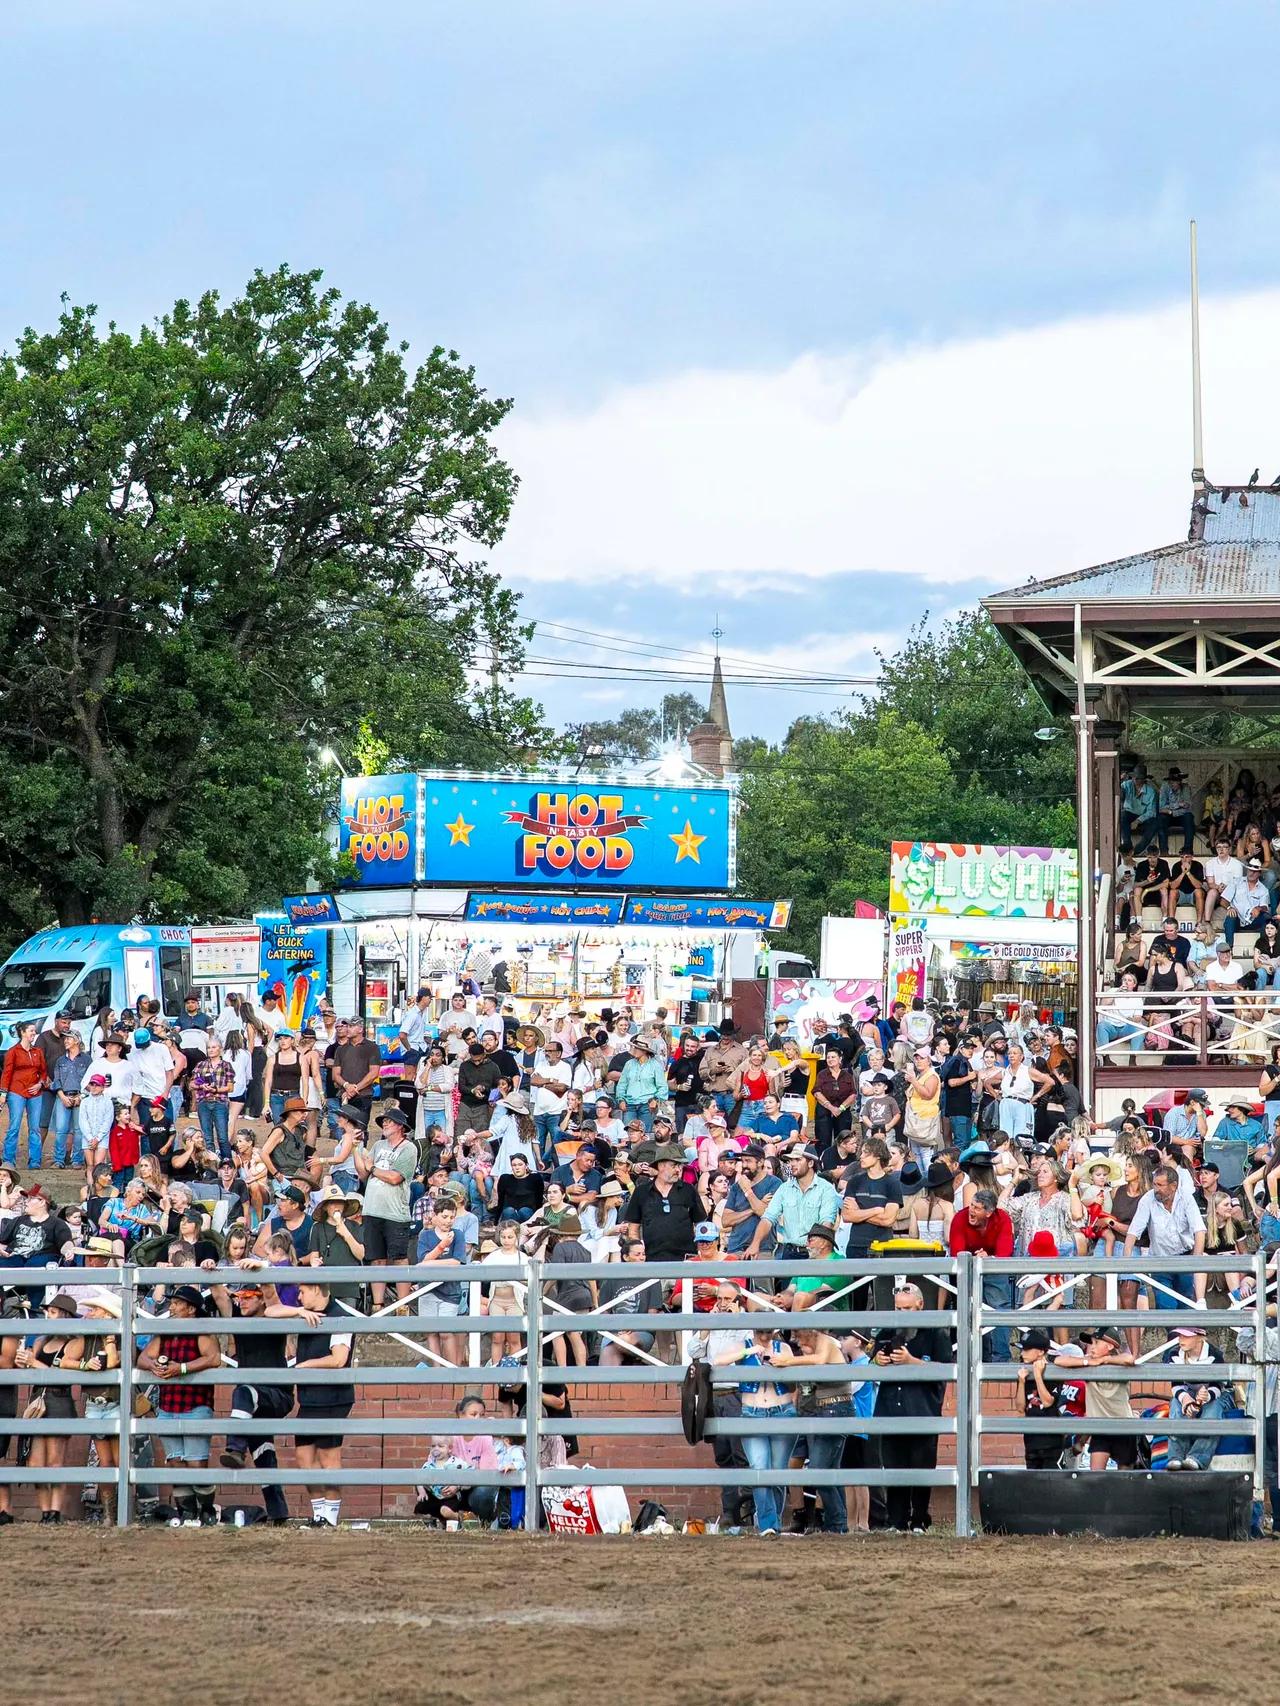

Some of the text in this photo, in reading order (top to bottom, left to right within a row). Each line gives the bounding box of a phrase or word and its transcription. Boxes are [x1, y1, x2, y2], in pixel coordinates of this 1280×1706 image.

[357, 795, 404, 824] HOT
[537, 793, 623, 827] HOT
[371, 824, 390, 834] TASTY
[564, 827, 599, 837] TASTY
[350, 831, 409, 863] FOOD
[523, 834, 634, 870] FOOD
[161, 930, 184, 940] CHOC
[274, 924, 291, 934] LET
[277, 937, 303, 947] BUCK
[896, 931, 923, 945] SUPER
[267, 949, 313, 960] CATERING
[896, 944, 923, 957] SIPPERS
[1001, 948, 1065, 958] ICE COLD SLUSHIES
[905, 974, 917, 985] 1/2
[898, 983, 918, 996] PRICE
[550, 1514, 587, 1527] HELLO
